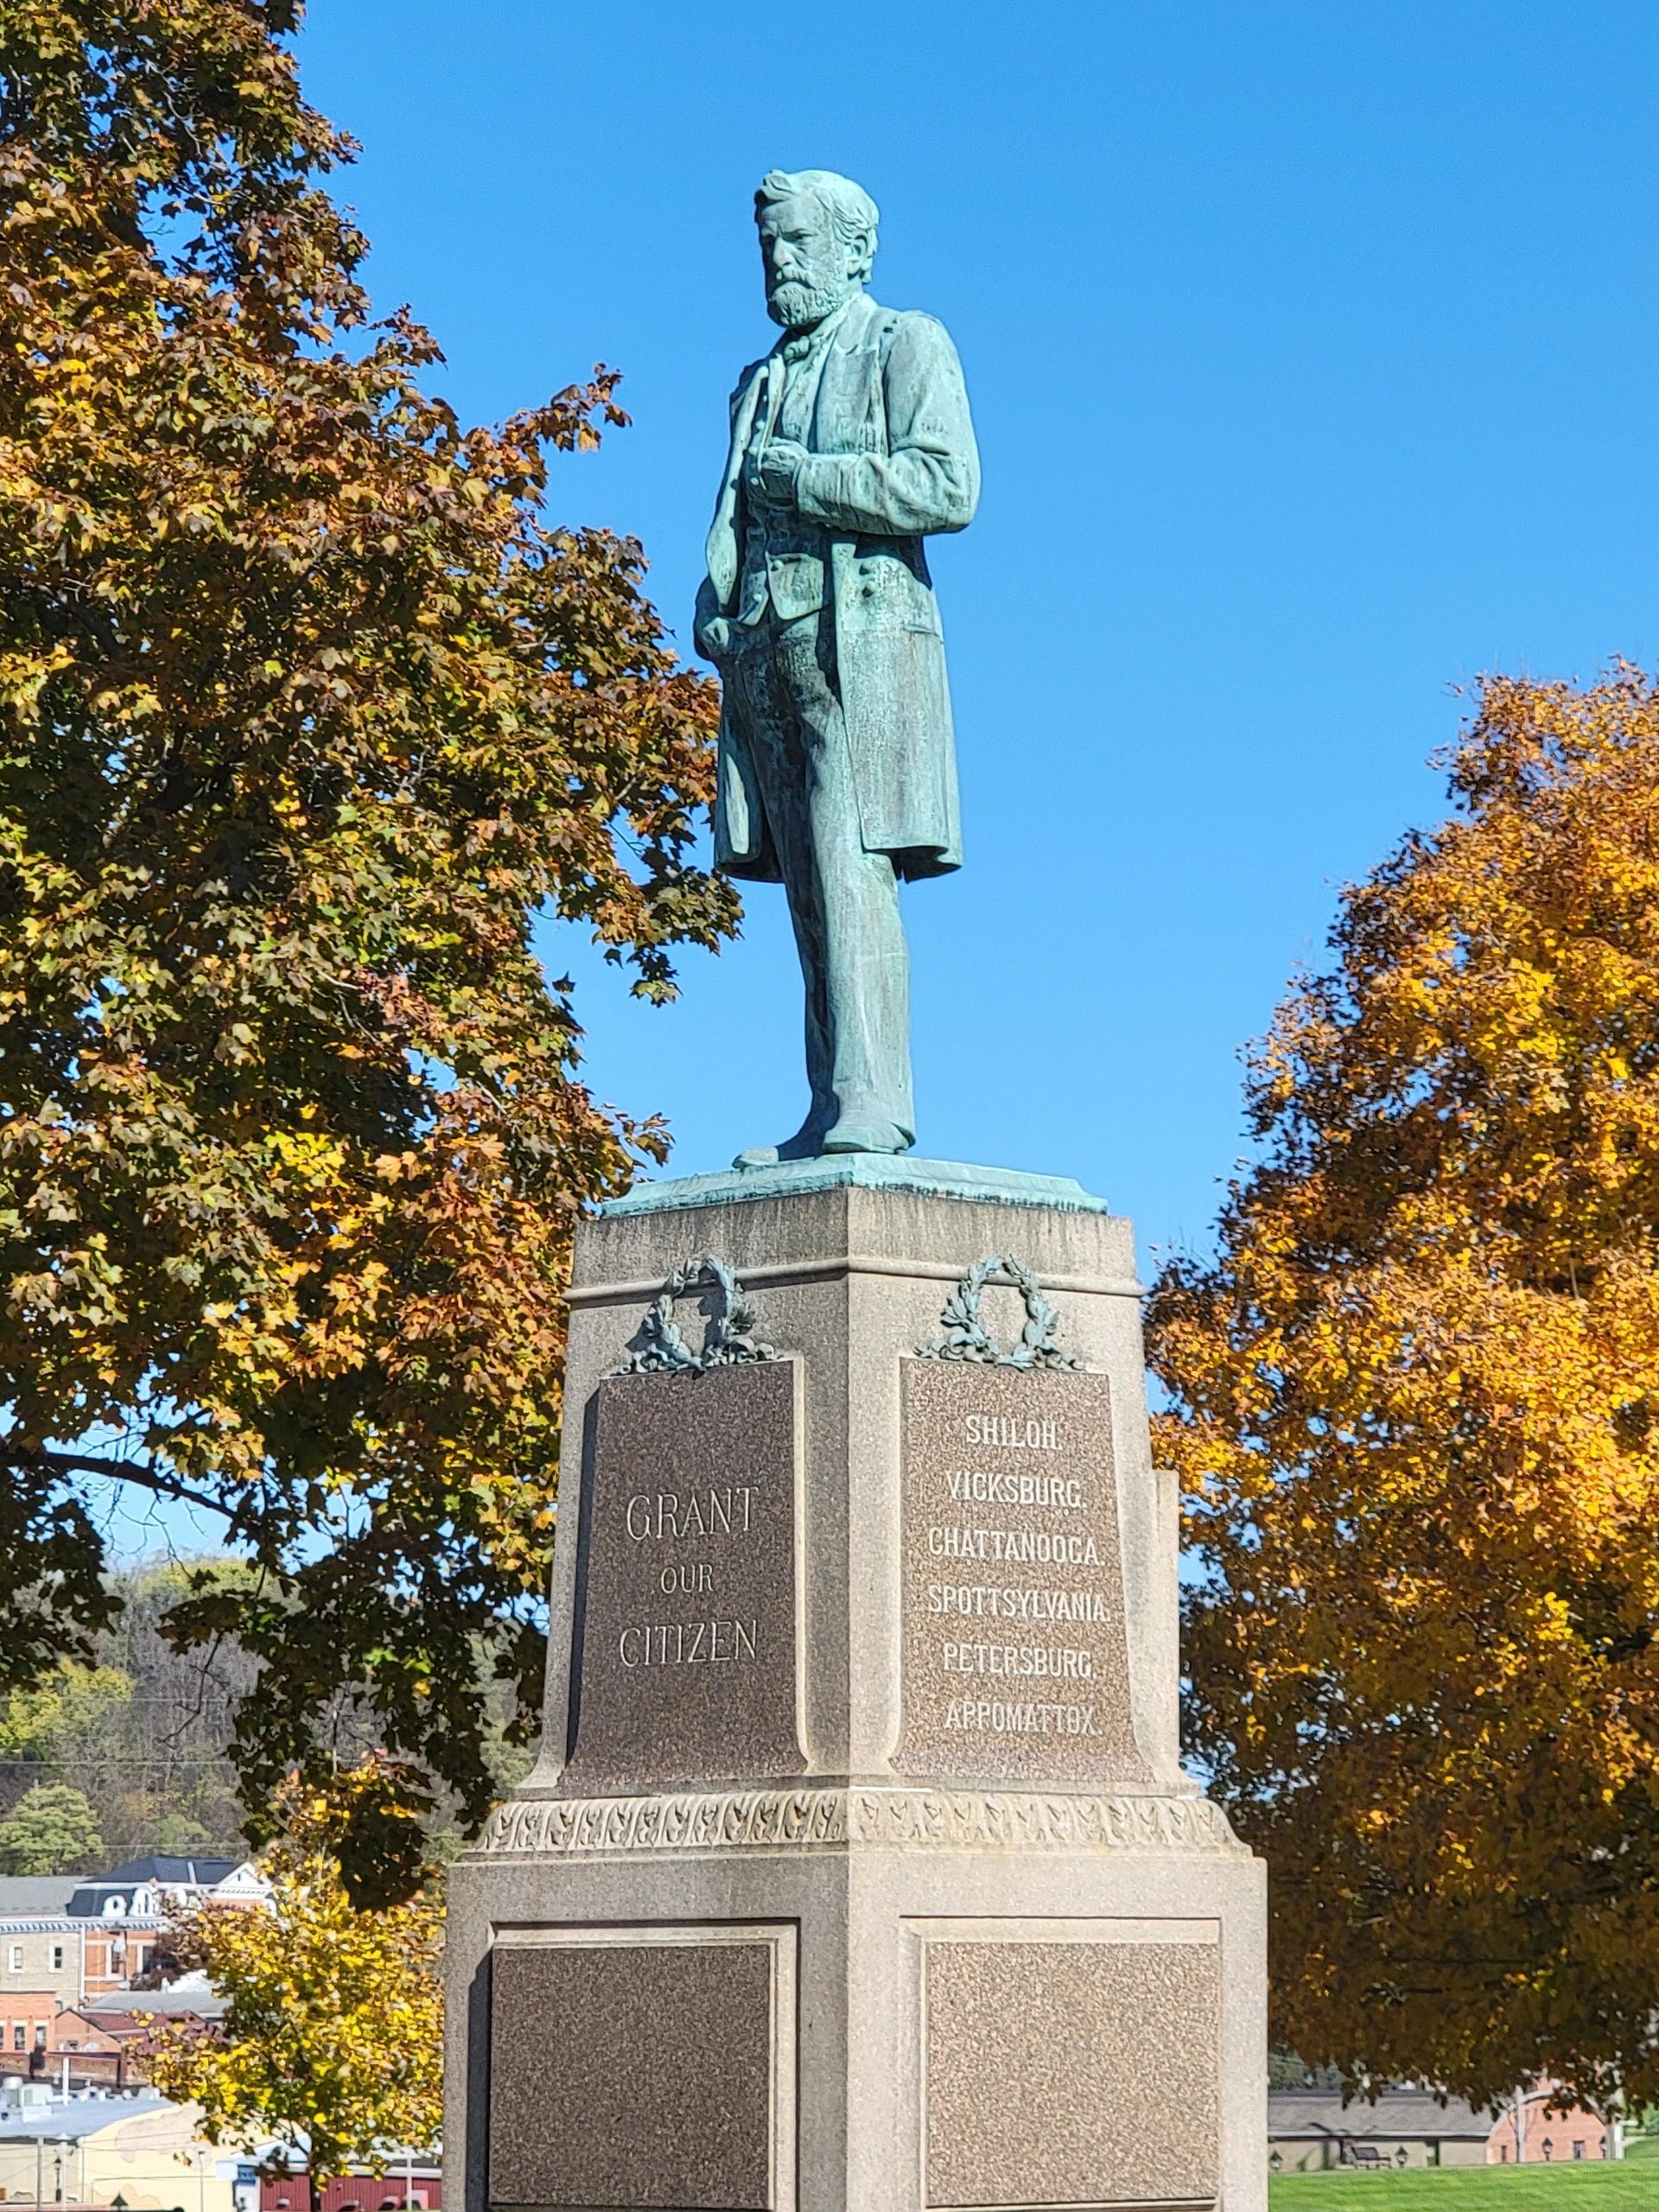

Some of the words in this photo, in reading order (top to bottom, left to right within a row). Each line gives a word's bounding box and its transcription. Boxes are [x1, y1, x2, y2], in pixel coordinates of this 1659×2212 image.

[626, 1486, 760, 1541] GRANT
[660, 1563, 714, 1594] OUR
[619, 1618, 758, 1668] CITIZEN
